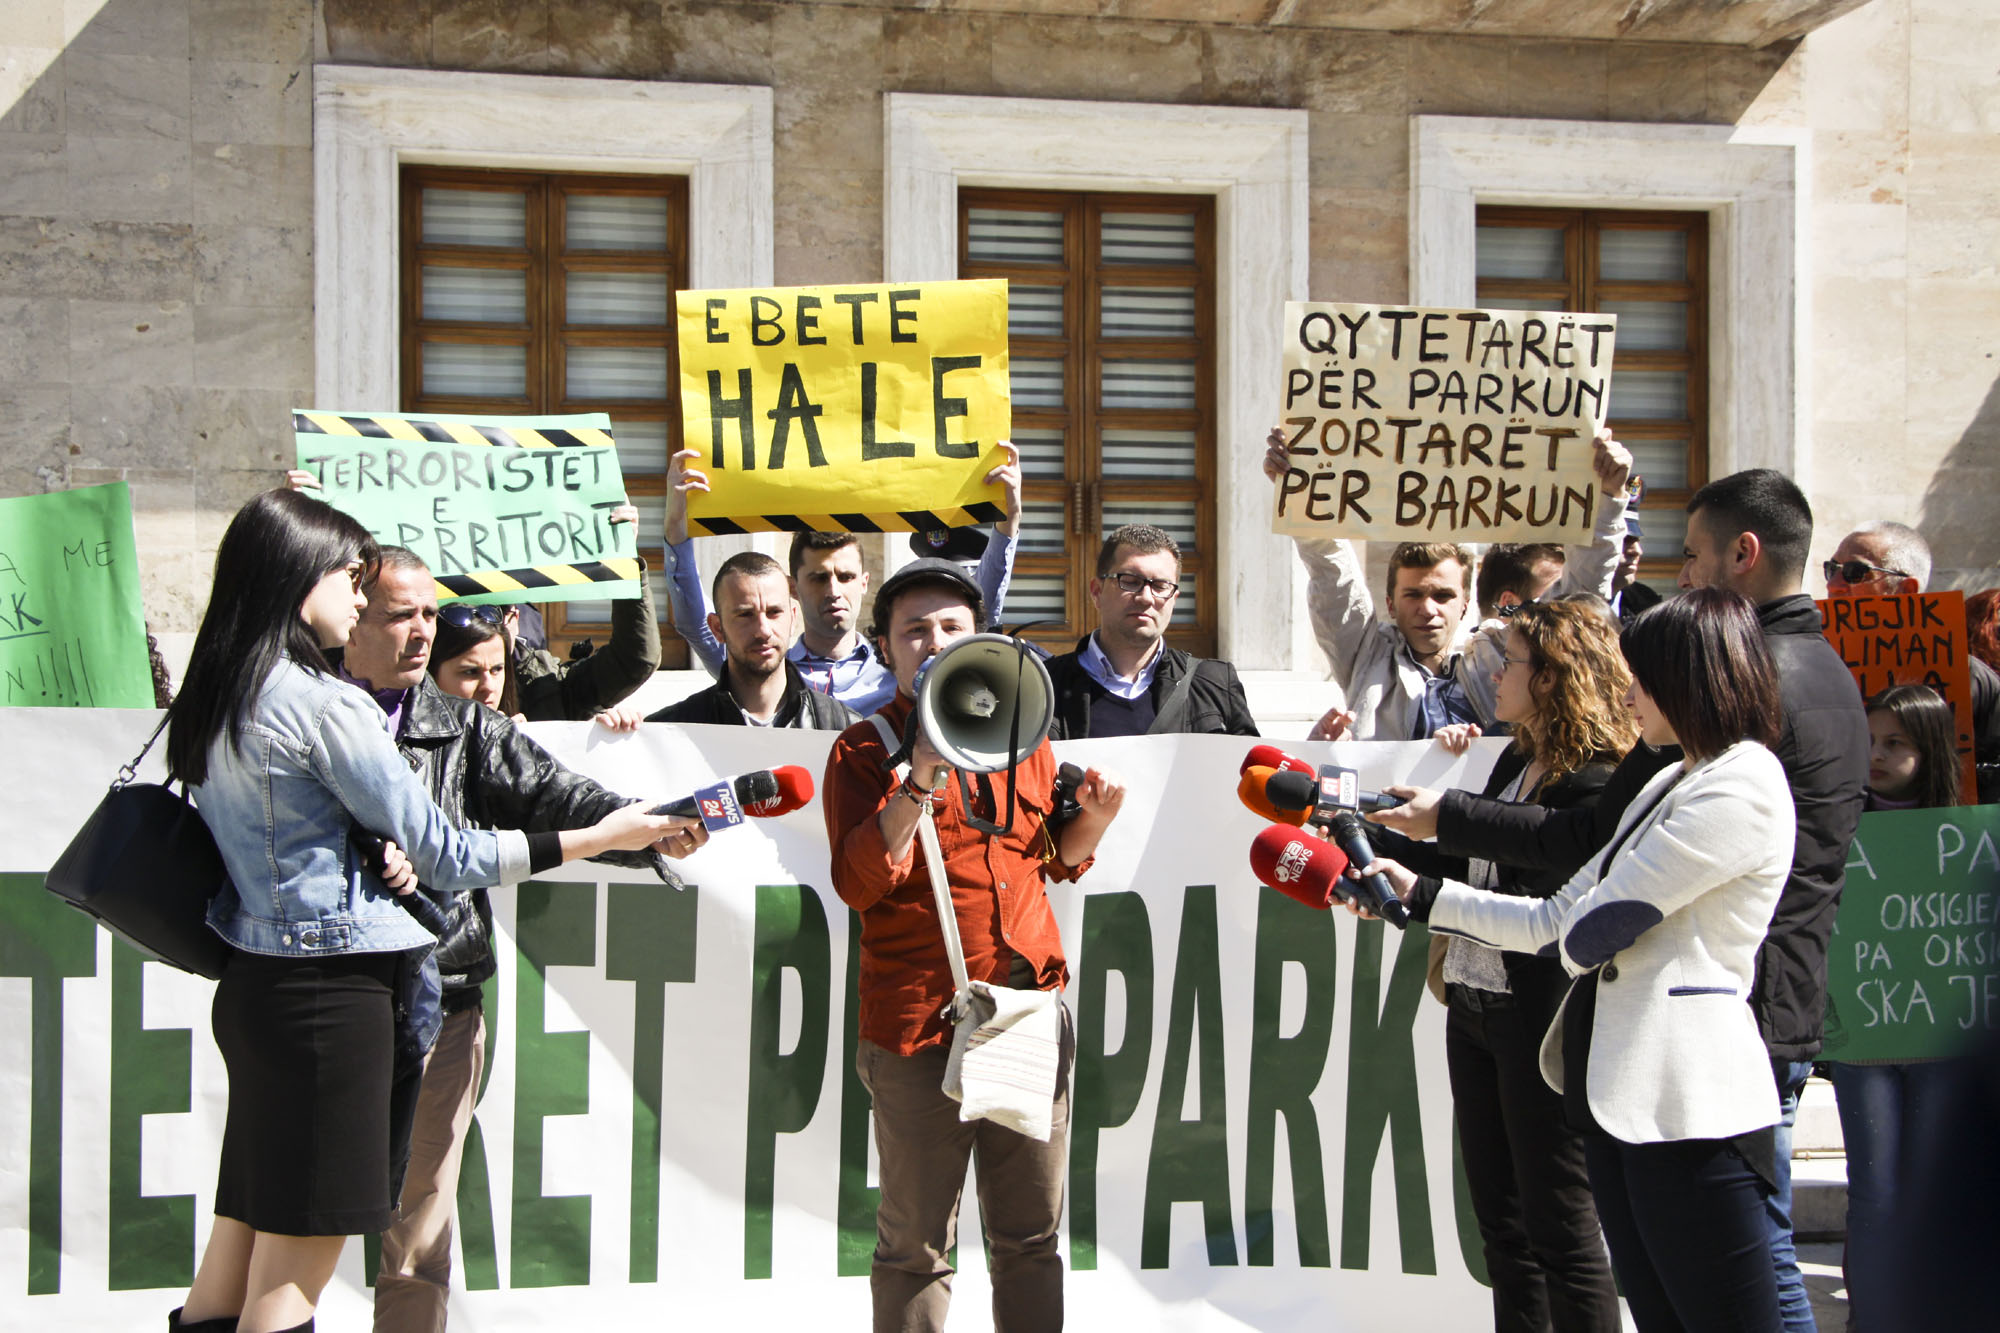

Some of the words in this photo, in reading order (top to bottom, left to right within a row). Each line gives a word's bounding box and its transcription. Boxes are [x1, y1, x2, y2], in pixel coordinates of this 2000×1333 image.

[1300, 311, 1614, 369] QYTETARËT
[1287, 361, 1381, 410] PËR
[1409, 368, 1604, 419] PARKUN
[707, 355, 982, 471] HALE
[1285, 417, 1581, 471] ZORTARËT
[433, 497, 460, 523] E
[1278, 461, 1372, 524] PËR
[1396, 470, 1593, 531] BARKUN
[64, 538, 114, 571] ME
[703, 800, 723, 817] 24
[717, 788, 740, 824] news
[1290, 849, 1313, 882] NEWS
[1855, 941, 1892, 973] PA
[1924, 932, 2000, 967] OKSI
